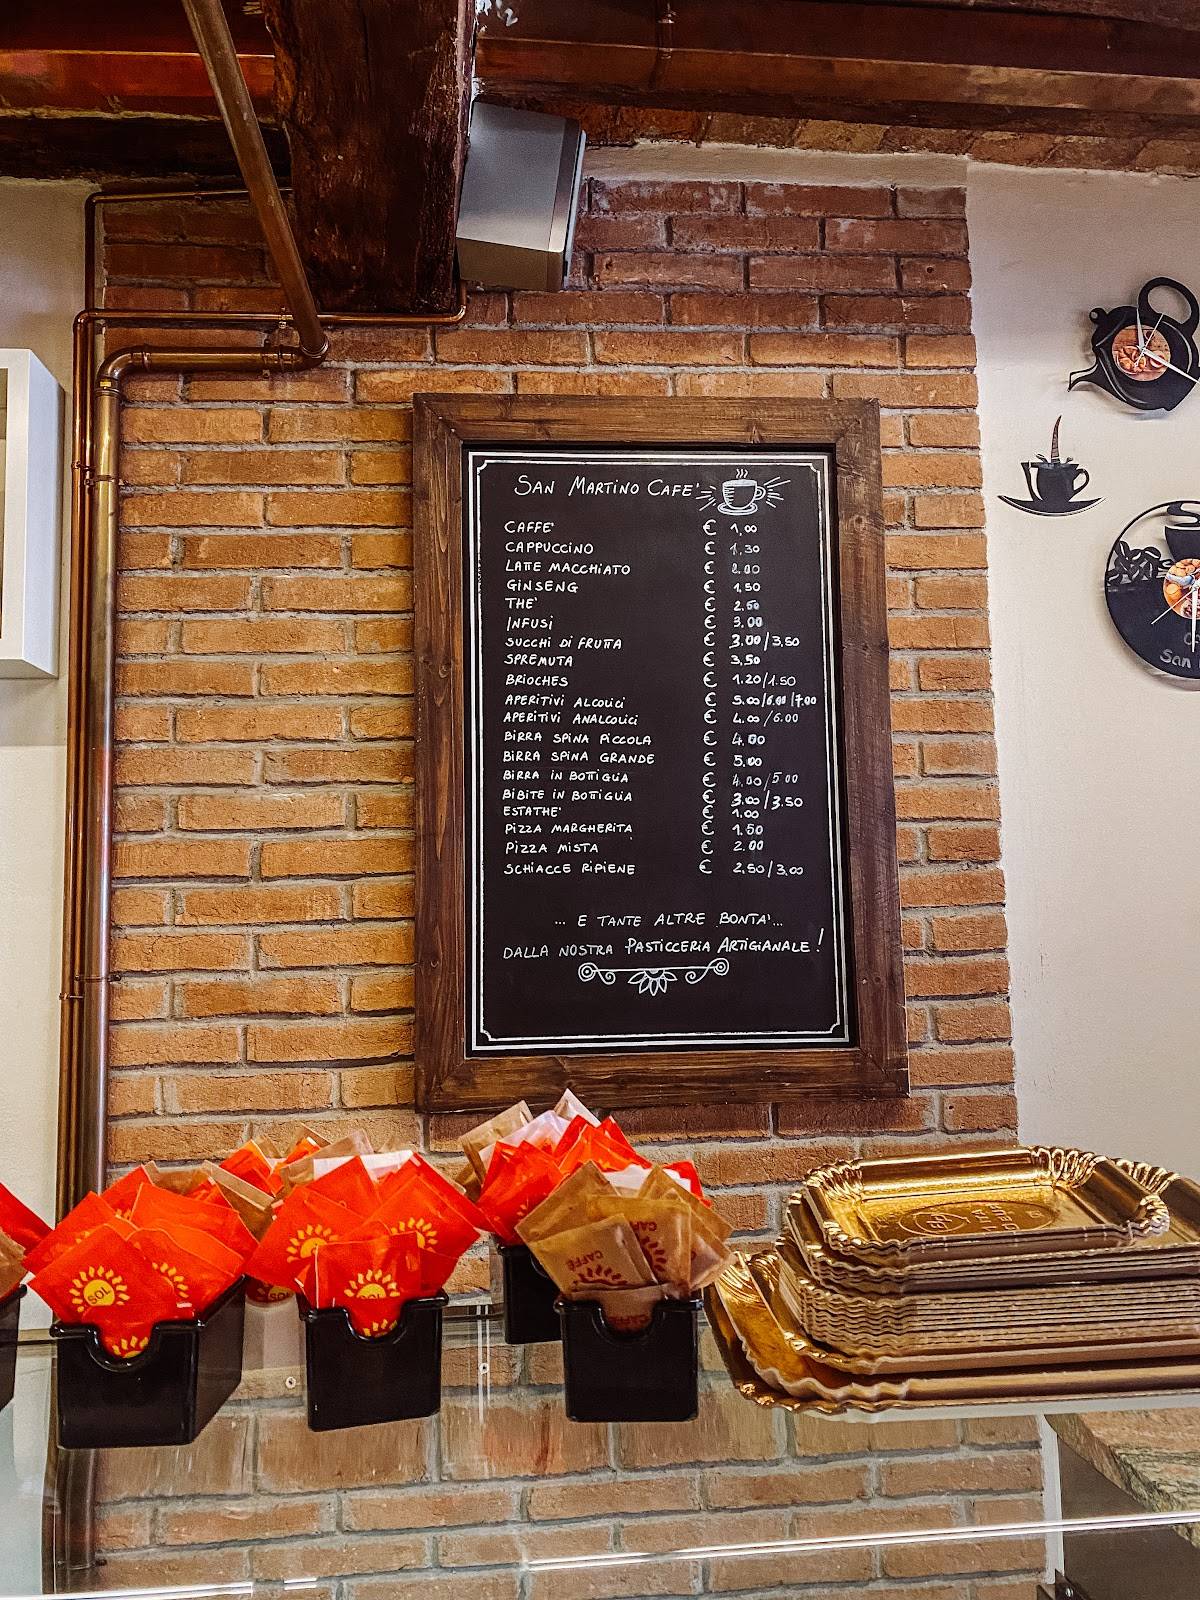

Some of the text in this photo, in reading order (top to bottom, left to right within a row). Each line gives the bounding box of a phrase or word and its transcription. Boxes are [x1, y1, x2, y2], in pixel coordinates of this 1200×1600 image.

[514, 475, 554, 495] SAN
[568, 476, 639, 496] MARTINO
[703, 519, 716, 535] €
[506, 542, 593, 554] CAPPUCCINO
[704, 541, 715, 555] €
[506, 560, 541, 571] LATTE
[548, 563, 630, 575] MACCHIATO
[704, 561, 714, 574] €
[507, 579, 578, 593] GINSENG
[704, 580, 715, 594] €
[705, 597, 715, 612] €
[507, 615, 553, 631] INFUSI
[705, 615, 716, 629] €
[505, 637, 551, 648] SUCCHI
[559, 636, 573, 647] DI
[578, 637, 621, 649] FRUTTA
[704, 632, 715, 646] €
[504, 654, 572, 666] SPREMUTA
[703, 651, 714, 667] €
[1159, 648, 1191, 669] San
[506, 674, 568, 686] BRIOCHES
[703, 672, 717, 688] €
[505, 694, 564, 706] APERITIVI
[705, 692, 716, 706] €
[503, 711, 560, 723] APERITIVI
[704, 709, 717, 724] €
[504, 730, 542, 742] BIRRA
[553, 733, 589, 743] SPINA
[600, 733, 651, 745] PICCOLA
[703, 730, 717, 745] €
[503, 751, 540, 762] BIRRA
[551, 751, 588, 761] SPINA
[600, 752, 654, 764] GRANDE
[704, 752, 716, 766] €
[503, 770, 539, 780] BIRRA
[551, 770, 562, 780] IN
[703, 772, 716, 790] €
[503, 788, 544, 800] BIBITE
[553, 789, 565, 799] IN
[702, 789, 715, 806] €
[702, 805, 713, 821] €
[505, 823, 541, 834] PIZZA
[551, 823, 632, 833] MARGHERITA
[702, 820, 714, 835] €
[506, 841, 547, 854] PIZZA
[557, 842, 598, 853] MISTA
[701, 840, 713, 854] €
[504, 862, 571, 874] SCHIACCE
[582, 861, 635, 875] RIPIENE
[699, 859, 712, 874] €
[578, 915, 587, 926] E
[597, 915, 641, 926] TANTE
[654, 913, 705, 926] ALTRE
[504, 945, 548, 959] DALLA
[559, 944, 612, 956] NOSTRA
[625, 938, 710, 954] PASTICCERIA
[88, 1286, 112, 1304] SOL
